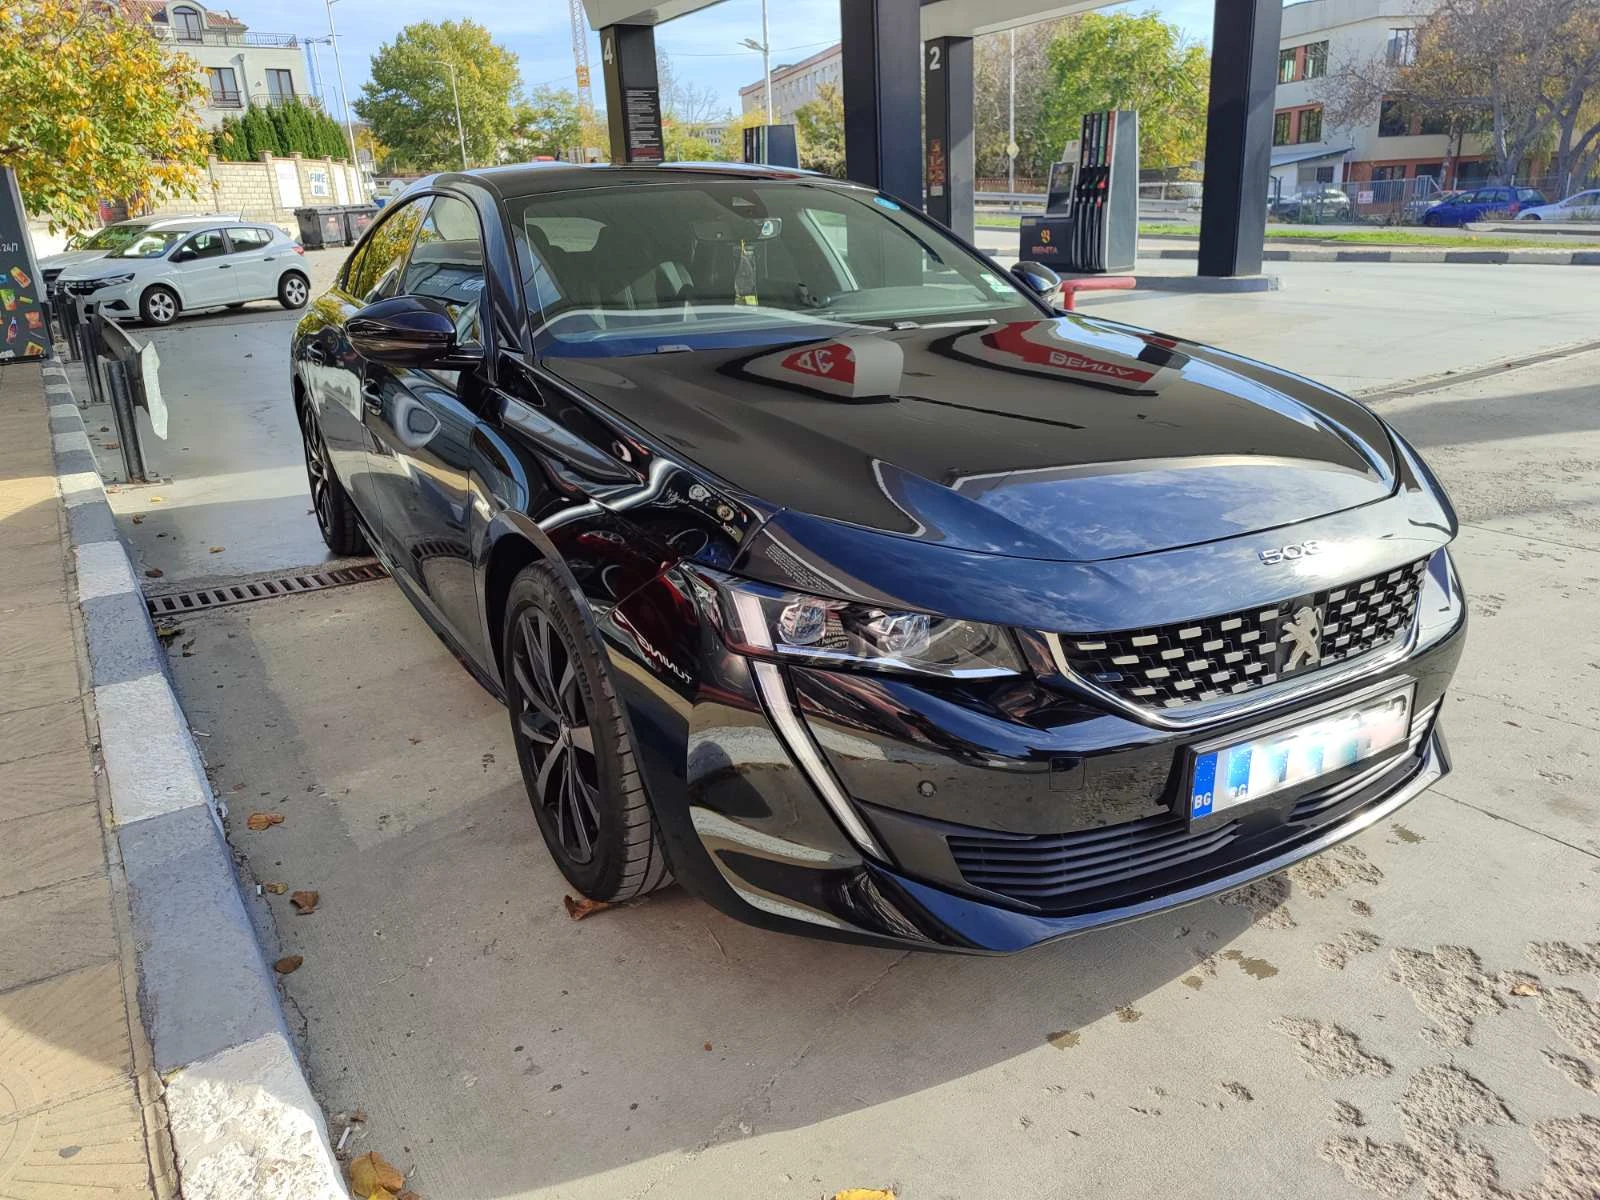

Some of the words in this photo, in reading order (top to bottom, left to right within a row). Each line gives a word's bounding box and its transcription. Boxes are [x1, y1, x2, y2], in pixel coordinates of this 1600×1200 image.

[603, 37, 613, 65] 4
[929, 46, 941, 70] 2
[1194, 791, 1213, 810] BG
